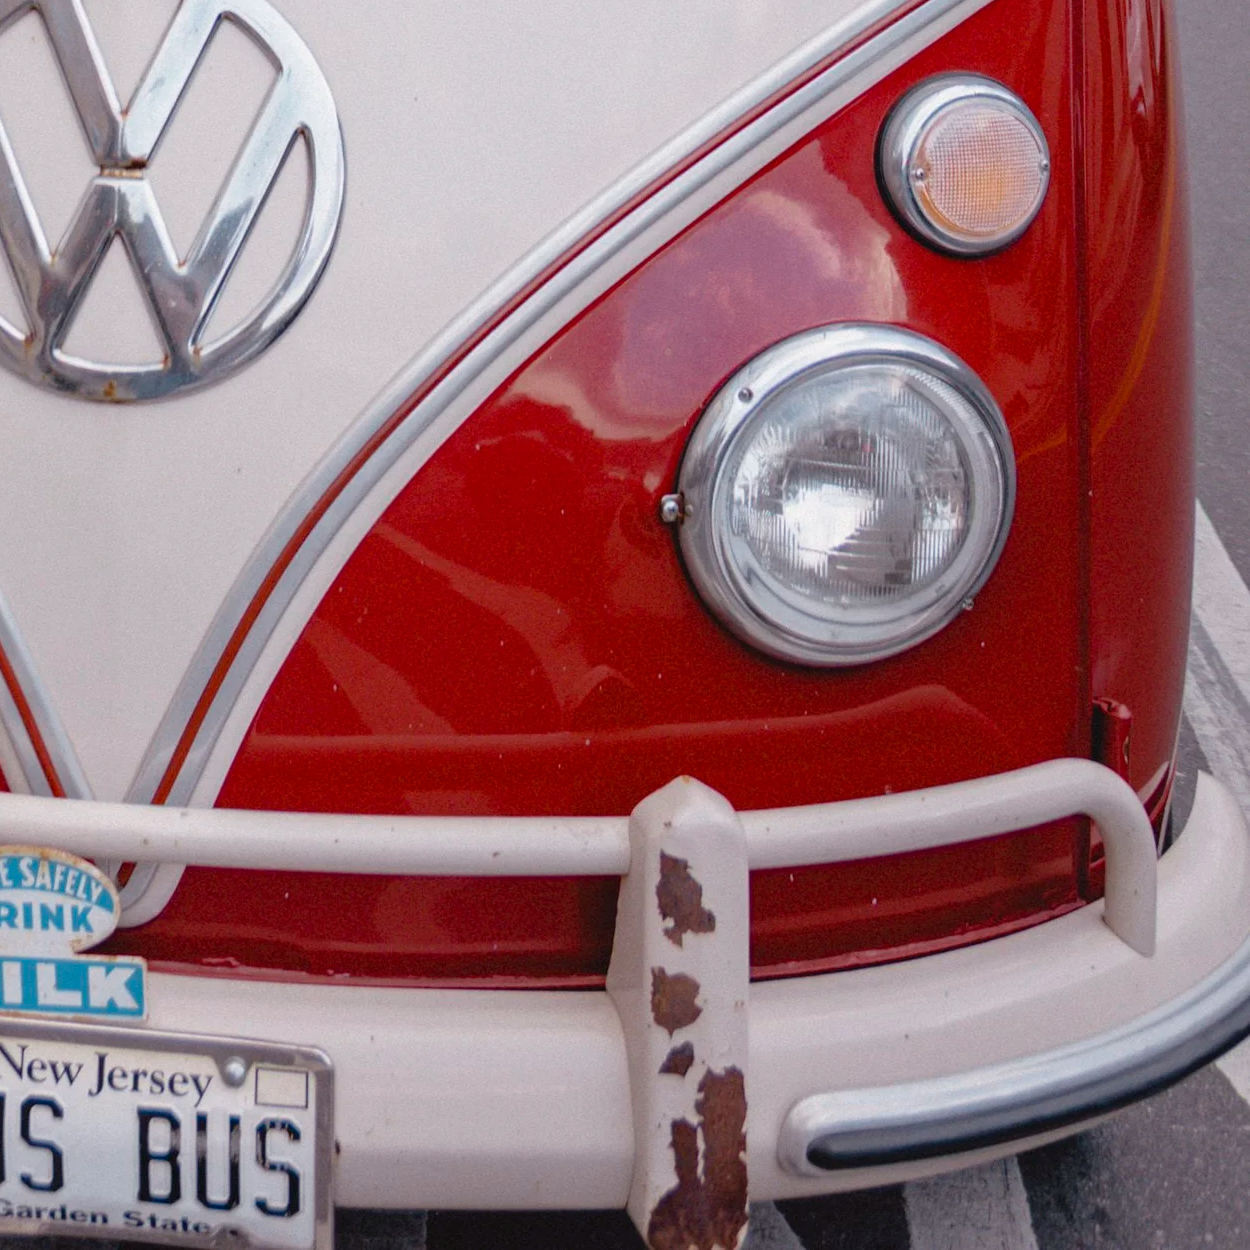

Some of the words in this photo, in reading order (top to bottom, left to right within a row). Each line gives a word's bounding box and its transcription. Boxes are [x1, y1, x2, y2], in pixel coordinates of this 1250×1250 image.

[19, 857, 103, 904] SAFELY
[88, 1052, 214, 1108] Jersey
[136, 1105, 301, 1218] BUS
[123, 1210, 212, 1235] State
